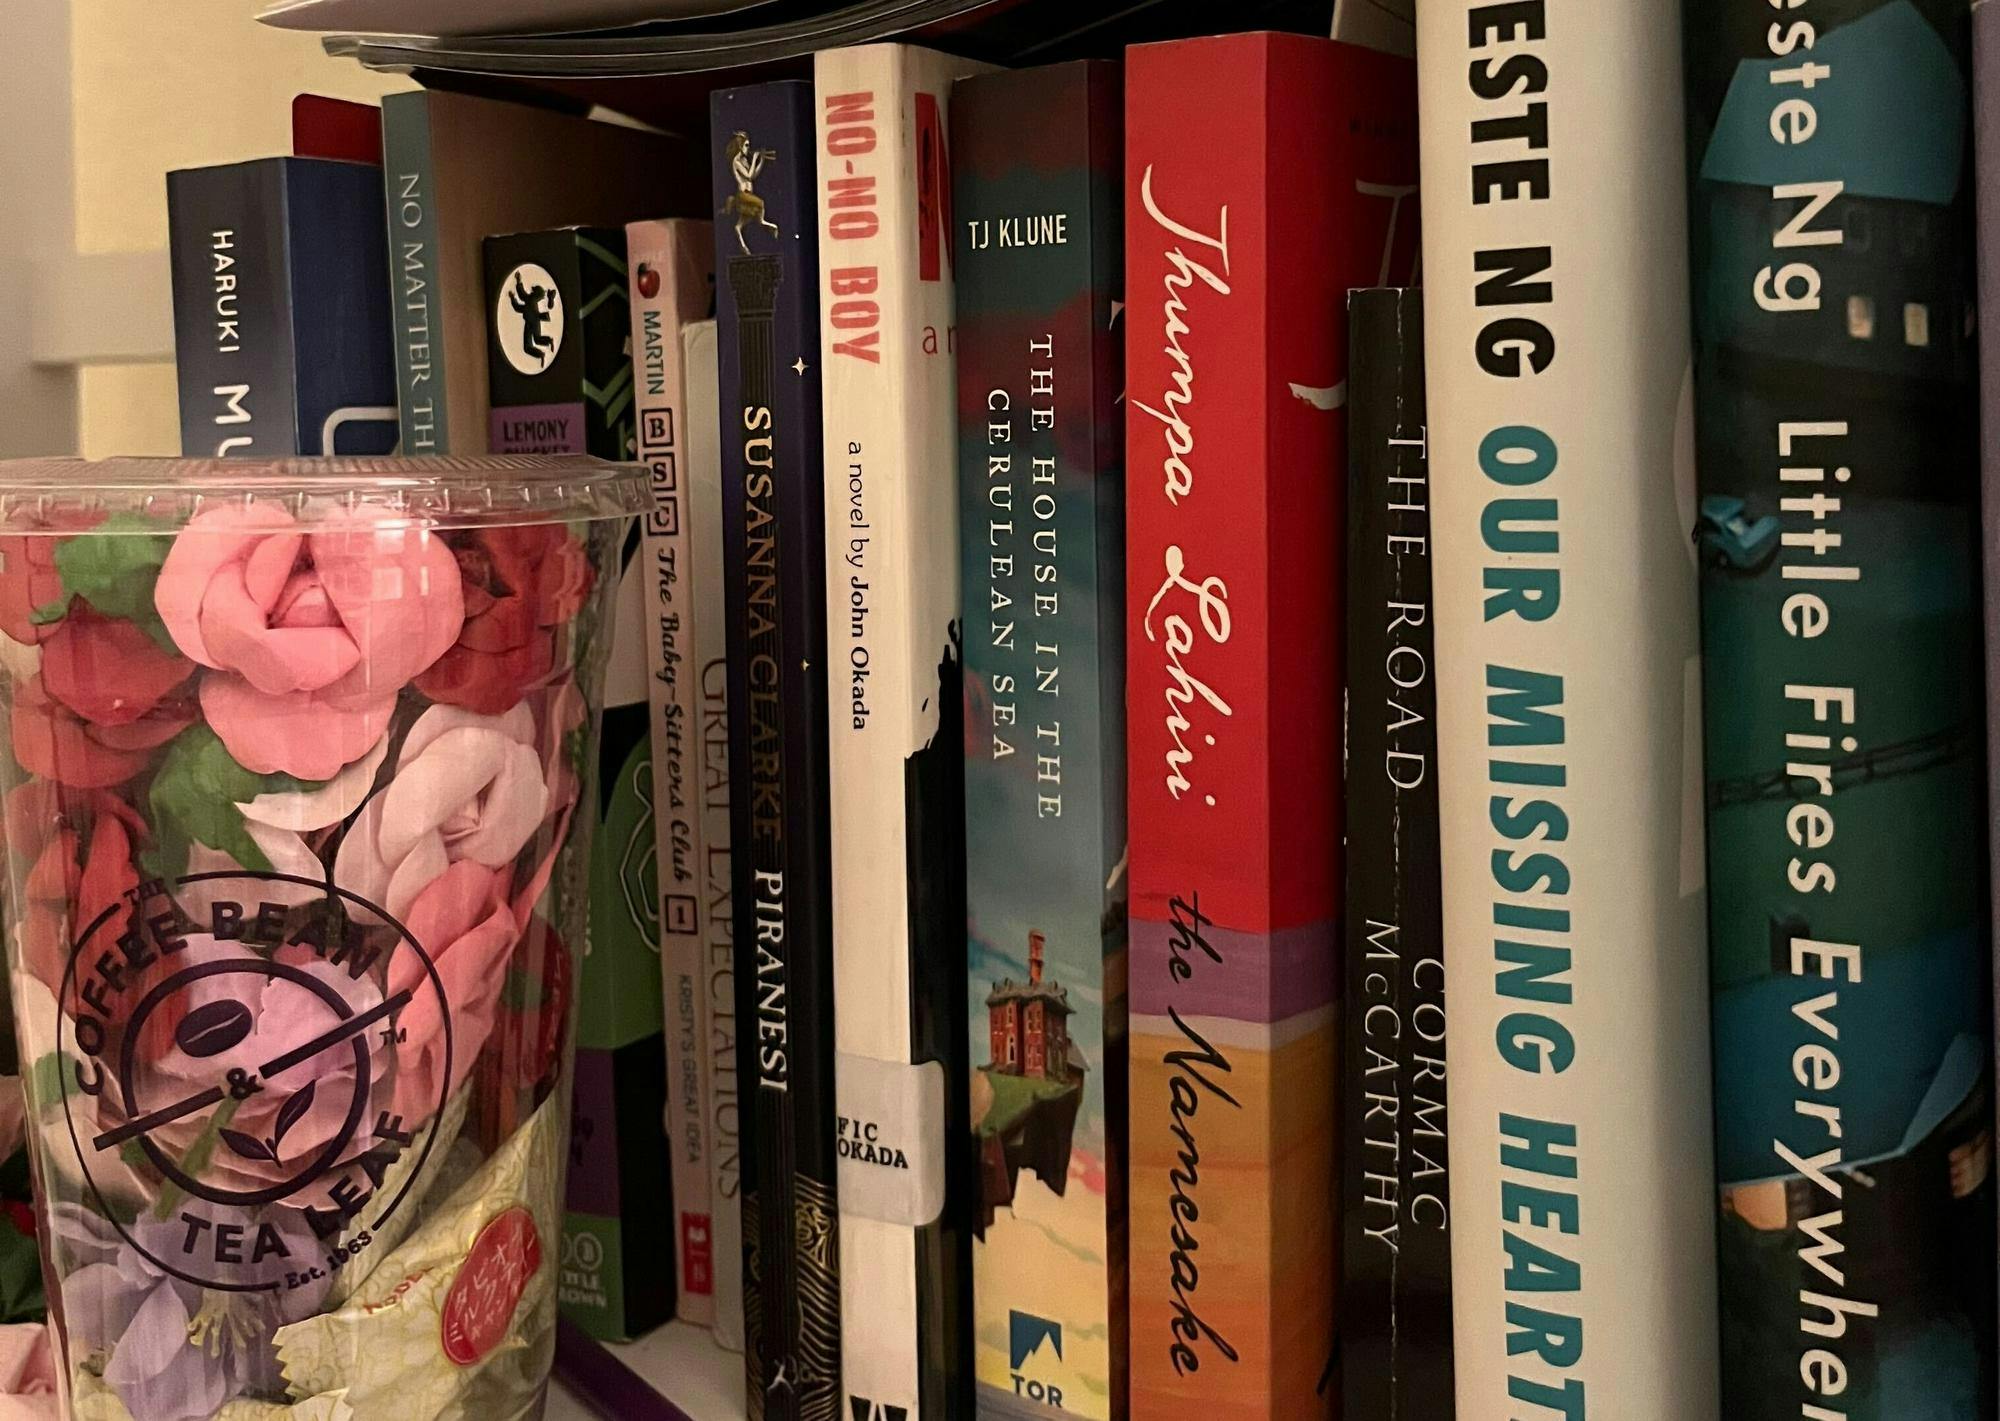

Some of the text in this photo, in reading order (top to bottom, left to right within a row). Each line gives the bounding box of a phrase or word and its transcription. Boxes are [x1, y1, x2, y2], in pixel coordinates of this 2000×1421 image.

[1767, 0, 1830, 145] ste
[400, 173, 422, 228] NO
[825, 91, 880, 364] NO-NO BOY
[968, 214, 1067, 250] TJ KLUNE
[1753, 180, 1844, 313] Ng
[212, 230, 240, 352] HARUKI
[403, 242, 431, 390] MATTER
[643, 310, 665, 395] MARTIN
[502, 419, 569, 442] LEMONY
[649, 417, 665, 438] B
[653, 462, 667, 482] S
[1132, 164, 1232, 806] Jhumpa Lahiri
[845, 441, 870, 731] a novel by John Okada
[988, 389, 1016, 760] CERULEAN SEA
[1030, 334, 1061, 818] THE HOUSE IN THE
[1386, 425, 1426, 789] THE ROAD
[1778, 421, 1861, 639] Little
[657, 547, 677, 604] The
[670, 818, 693, 884] Club
[701, 657, 730, 812] GREAT
[743, 406, 788, 1093] SUSANNA CLARKE PIRANESI
[1468, 0, 1586, 1421] ESTE NG OUR MISSING HEART
[1784, 684, 1860, 893] Fires
[75, 901, 383, 1096] COFFEE BEAN
[679, 975, 702, 1164] KRISTY'S GREAT IDEA
[226, 1067, 264, 1100] &
[837, 1116, 878, 1141] FIC
[837, 1139, 909, 1169] OKADA
[1163, 890, 1242, 1378] the Namesake
[1363, 919, 1402, 1255] McCARTHY
[1410, 957, 1447, 1231] CORMAC
[181, 1110, 416, 1264] TEA LEAF
[285, 1230, 373, 1290] Est. 1963
[1010, 1373, 1063, 1408] TOR
